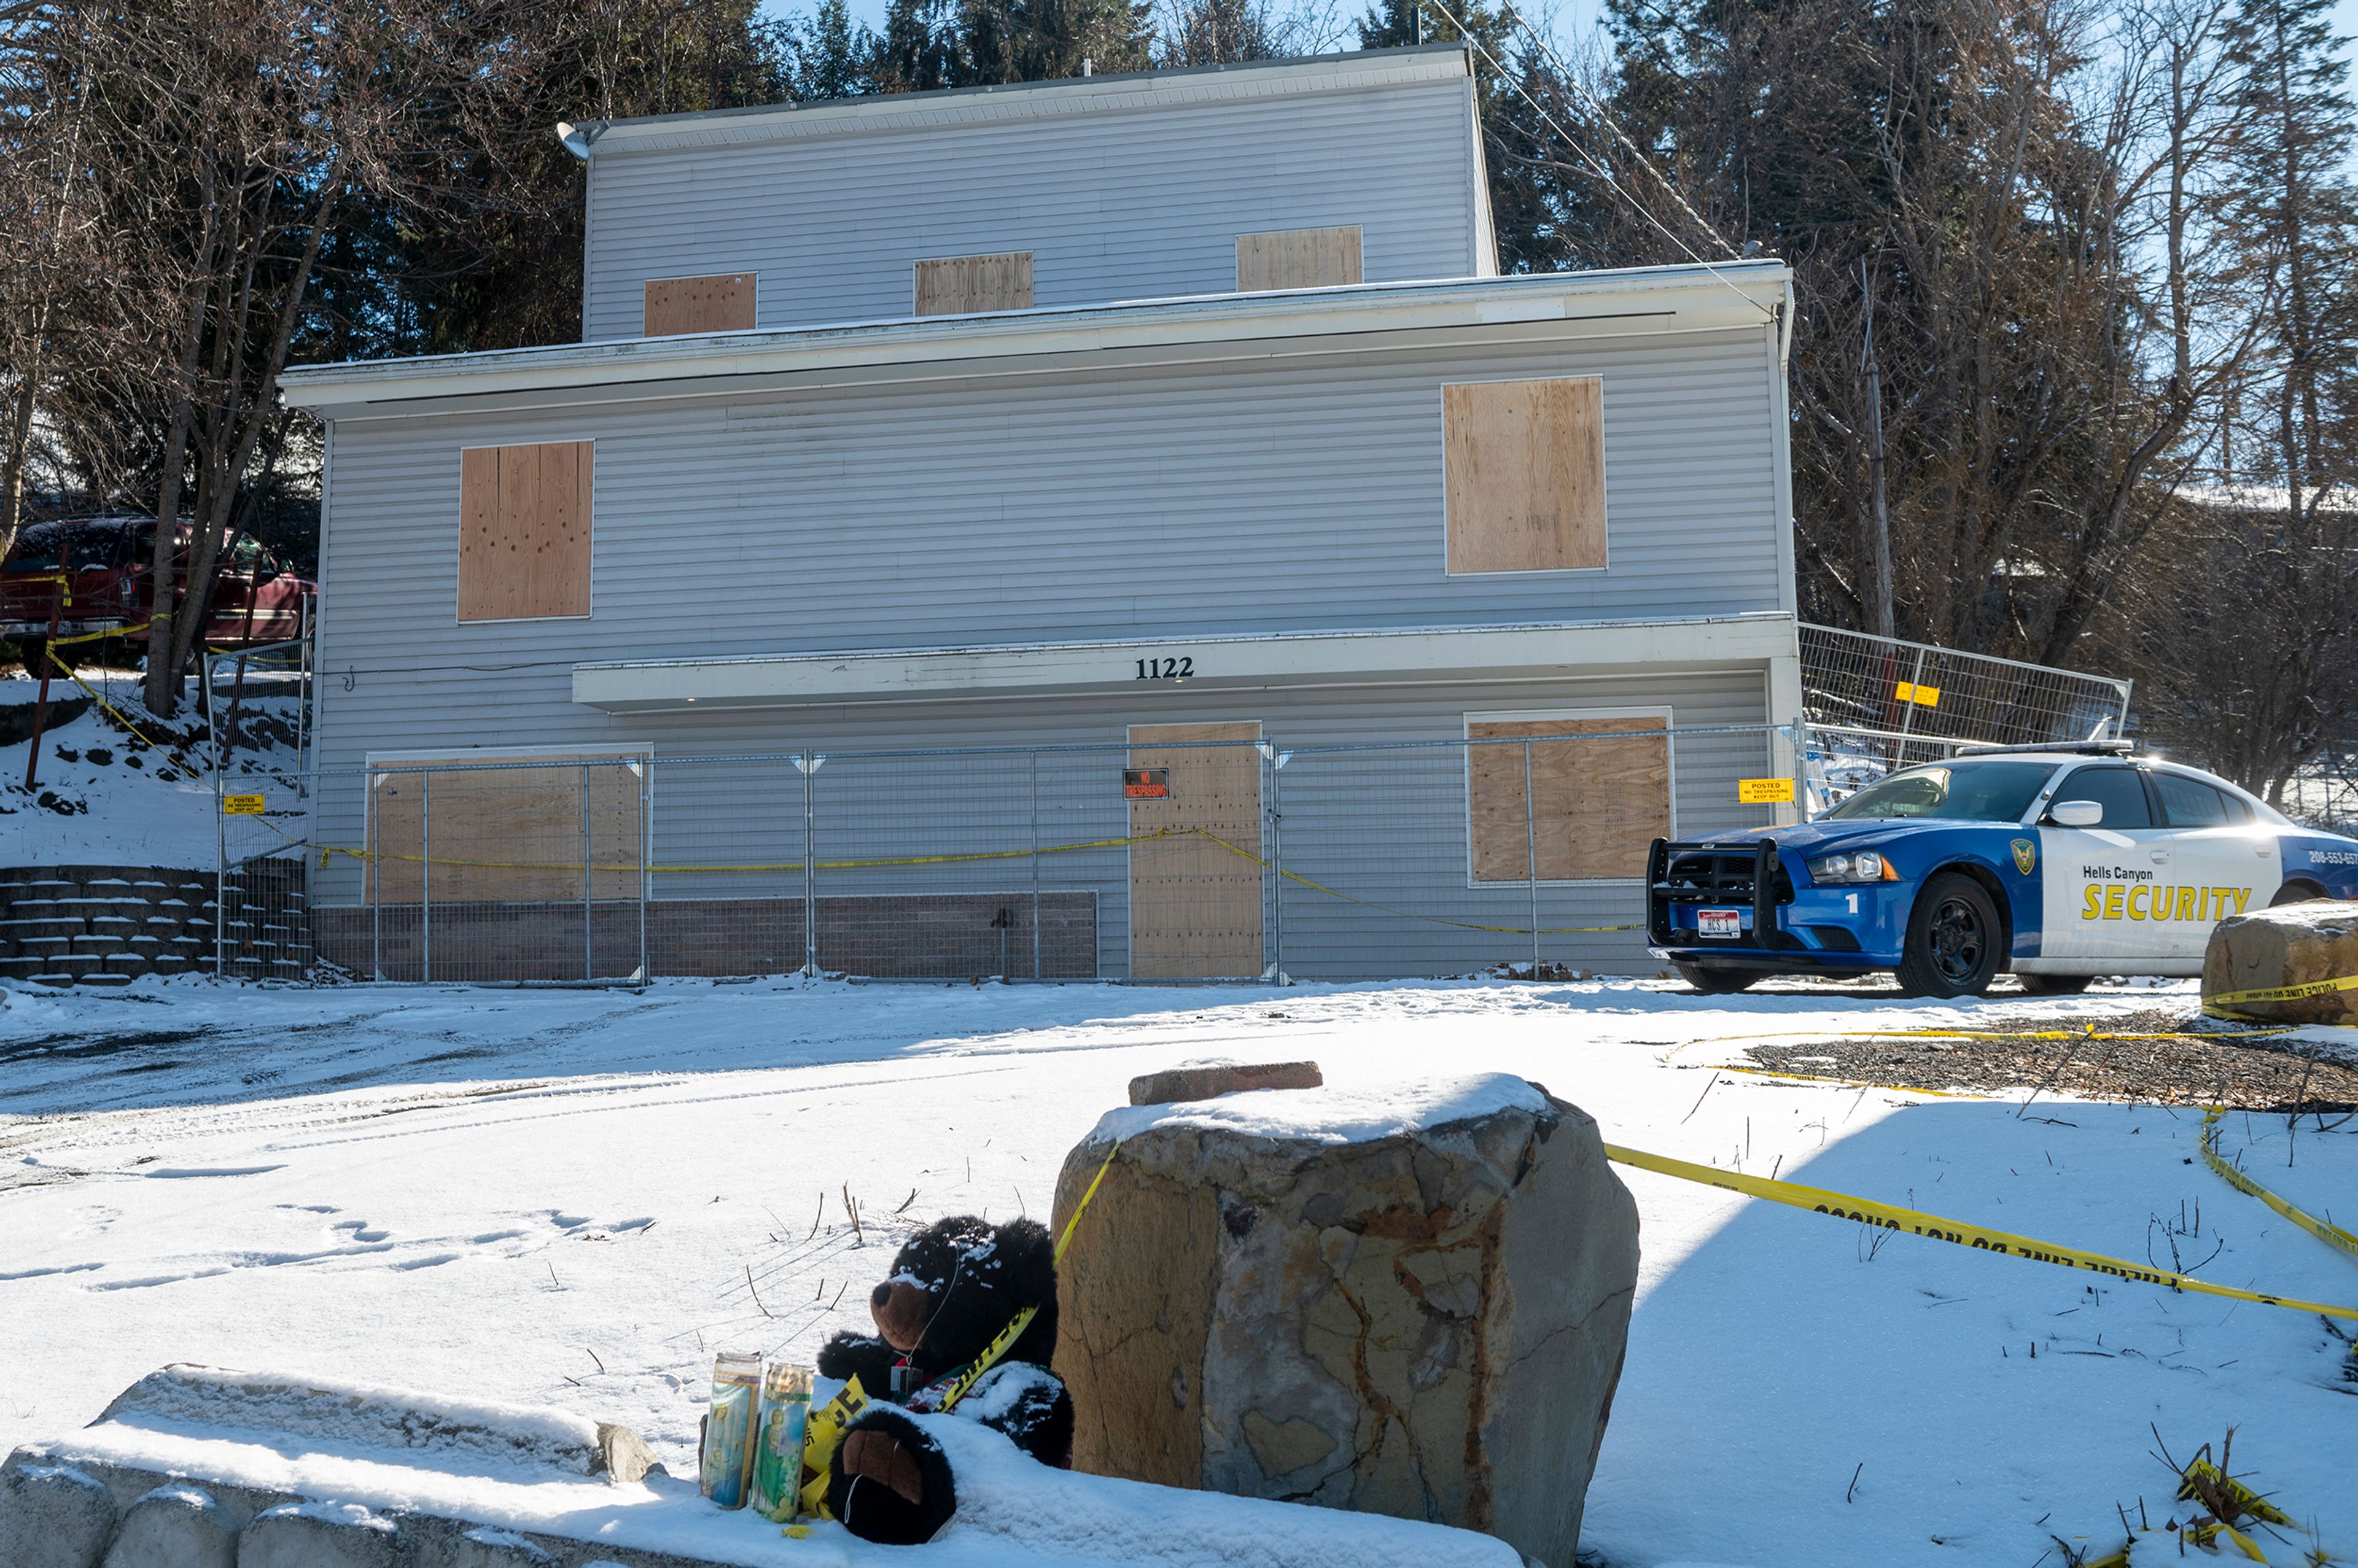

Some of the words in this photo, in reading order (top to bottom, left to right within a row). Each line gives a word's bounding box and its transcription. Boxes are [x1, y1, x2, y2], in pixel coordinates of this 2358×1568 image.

[1136, 656, 1194, 680] 1122
[1141, 772, 1150, 784] NO
[1126, 784, 1166, 798] TRESPASSING
[2308, 850, 2358, 865] 208-553-657
[2083, 866, 2112, 879] Hells
[2114, 866, 2153, 882] Canyon
[1845, 893, 1858, 914] 1
[2082, 883, 2252, 921] SECURITY
[1708, 919, 1721, 931] HCS
[1726, 920, 1730, 931] 1
[2285, 988, 2306, 998] LINE
[2306, 982, 2338, 996] POLICE
